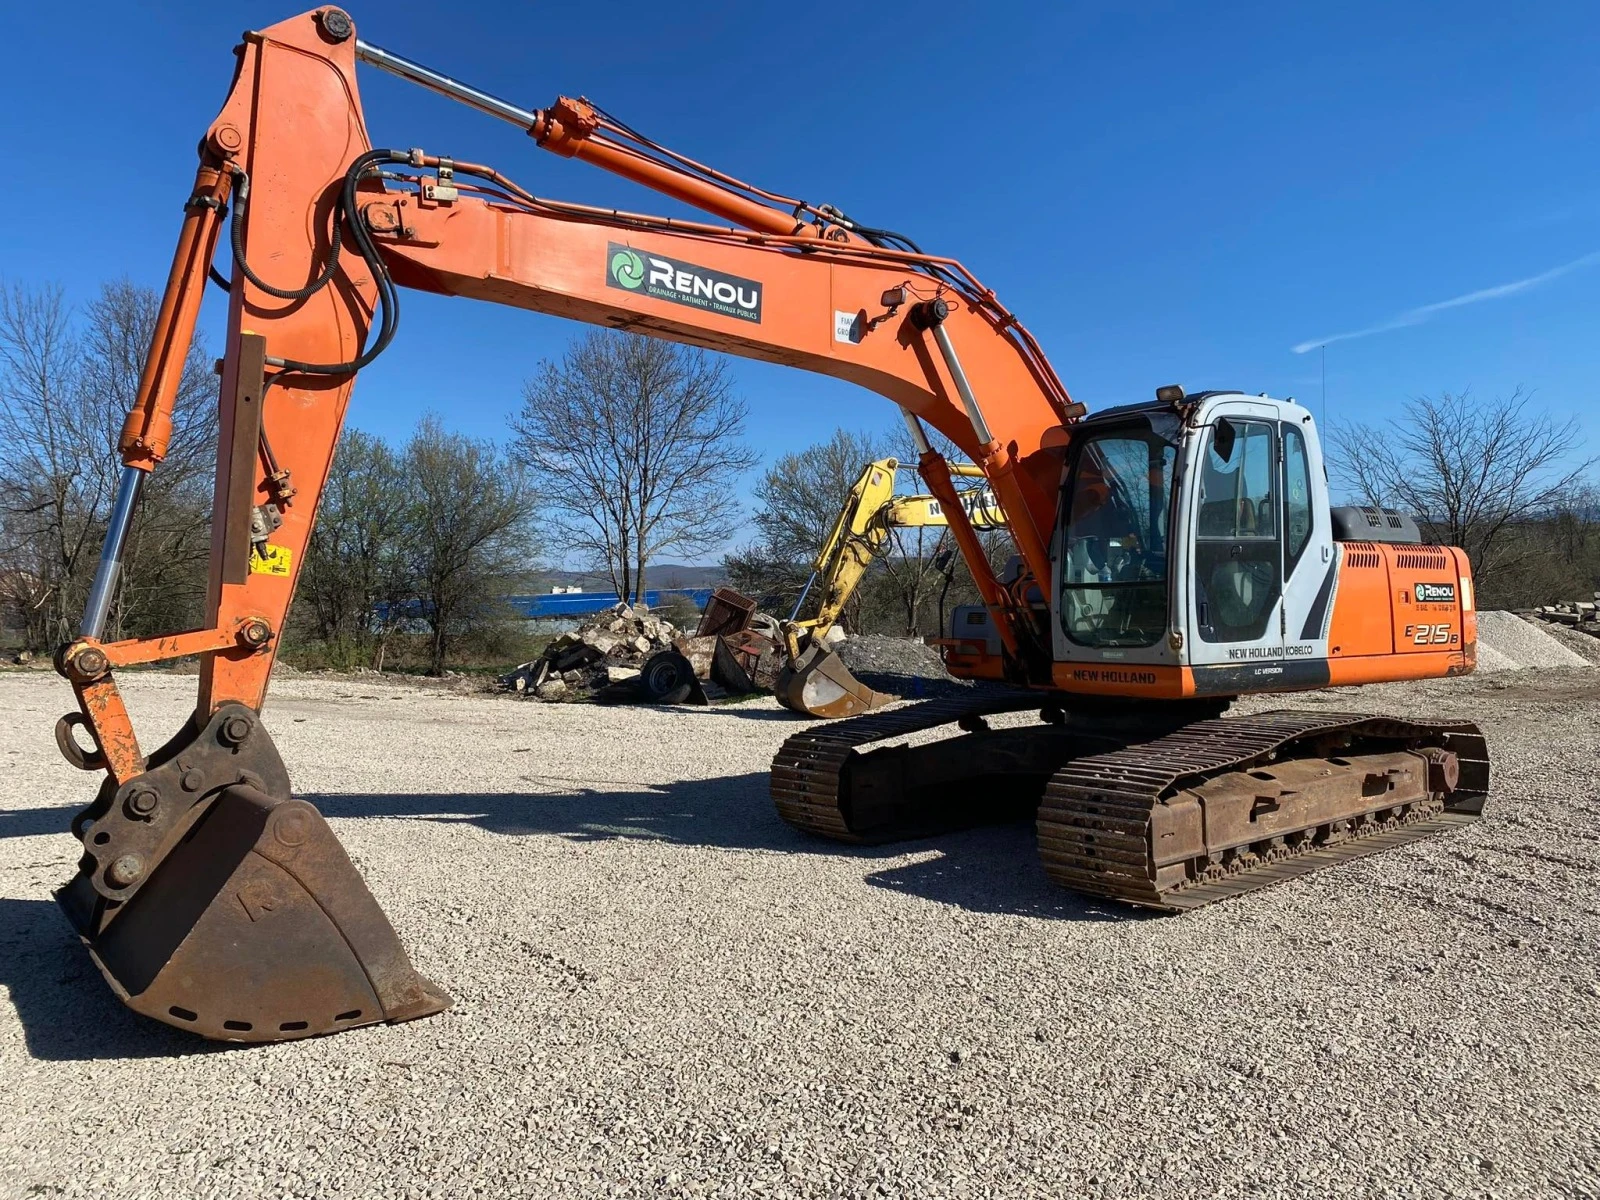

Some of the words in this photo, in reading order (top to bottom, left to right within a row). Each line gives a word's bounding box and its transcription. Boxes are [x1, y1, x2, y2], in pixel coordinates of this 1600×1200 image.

[648, 257, 758, 309] RENOU
[649, 285, 677, 299] DRAINAGE
[682, 294, 708, 307] BATIMENT
[713, 302, 736, 315] TRAVAUX
[737, 308, 757, 320] PUBLICS
[1424, 584, 1454, 597] RENOU
[1229, 649, 1247, 659] NEW
[1248, 647, 1283, 658] HOLLAND
[1285, 645, 1313, 656] KOBELCO
[1073, 670, 1098, 681] NEW
[1101, 671, 1157, 685] HOLLAND
[1262, 667, 1284, 675] VERSION
